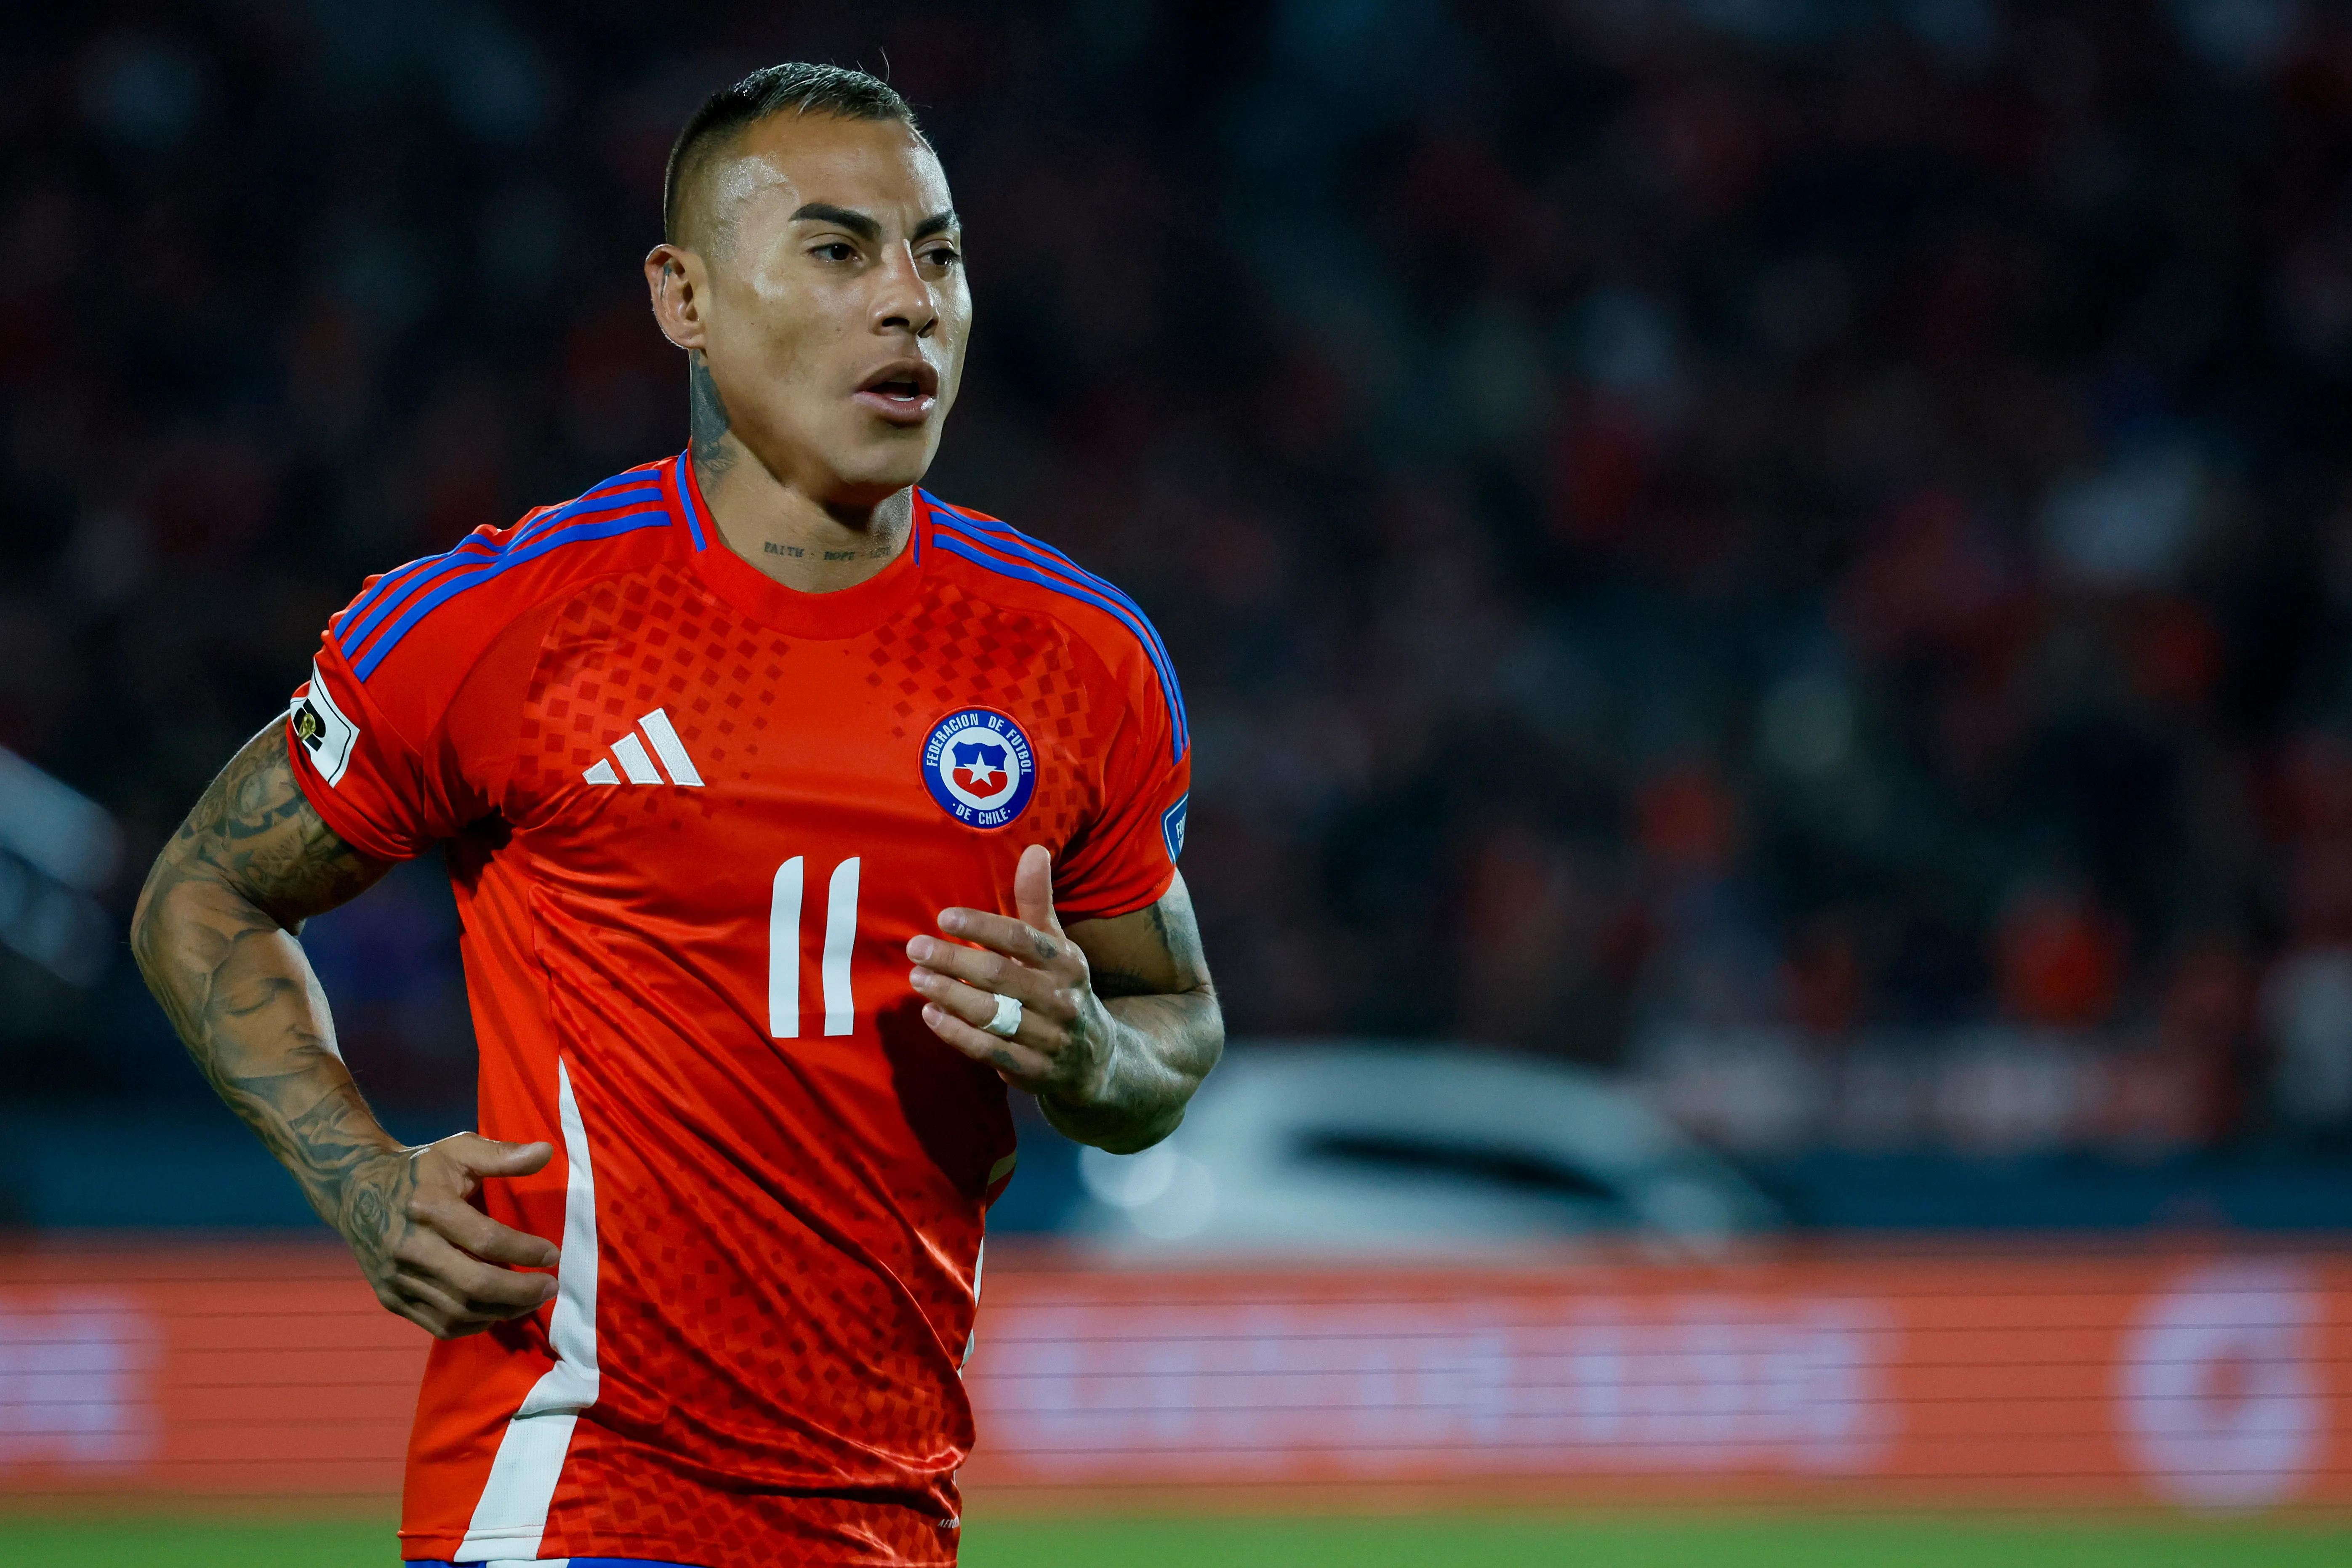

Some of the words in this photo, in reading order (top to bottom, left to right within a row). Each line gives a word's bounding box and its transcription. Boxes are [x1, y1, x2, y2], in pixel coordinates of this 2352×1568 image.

[764, 541, 804, 557] FAITH
[926, 713, 979, 767] FEDERACION
[988, 715, 1004, 732] DE
[1006, 728, 1032, 775] FUTBOL
[955, 803, 972, 820] DE
[978, 807, 1009, 825] CHILE
[768, 855, 860, 1038] 11
